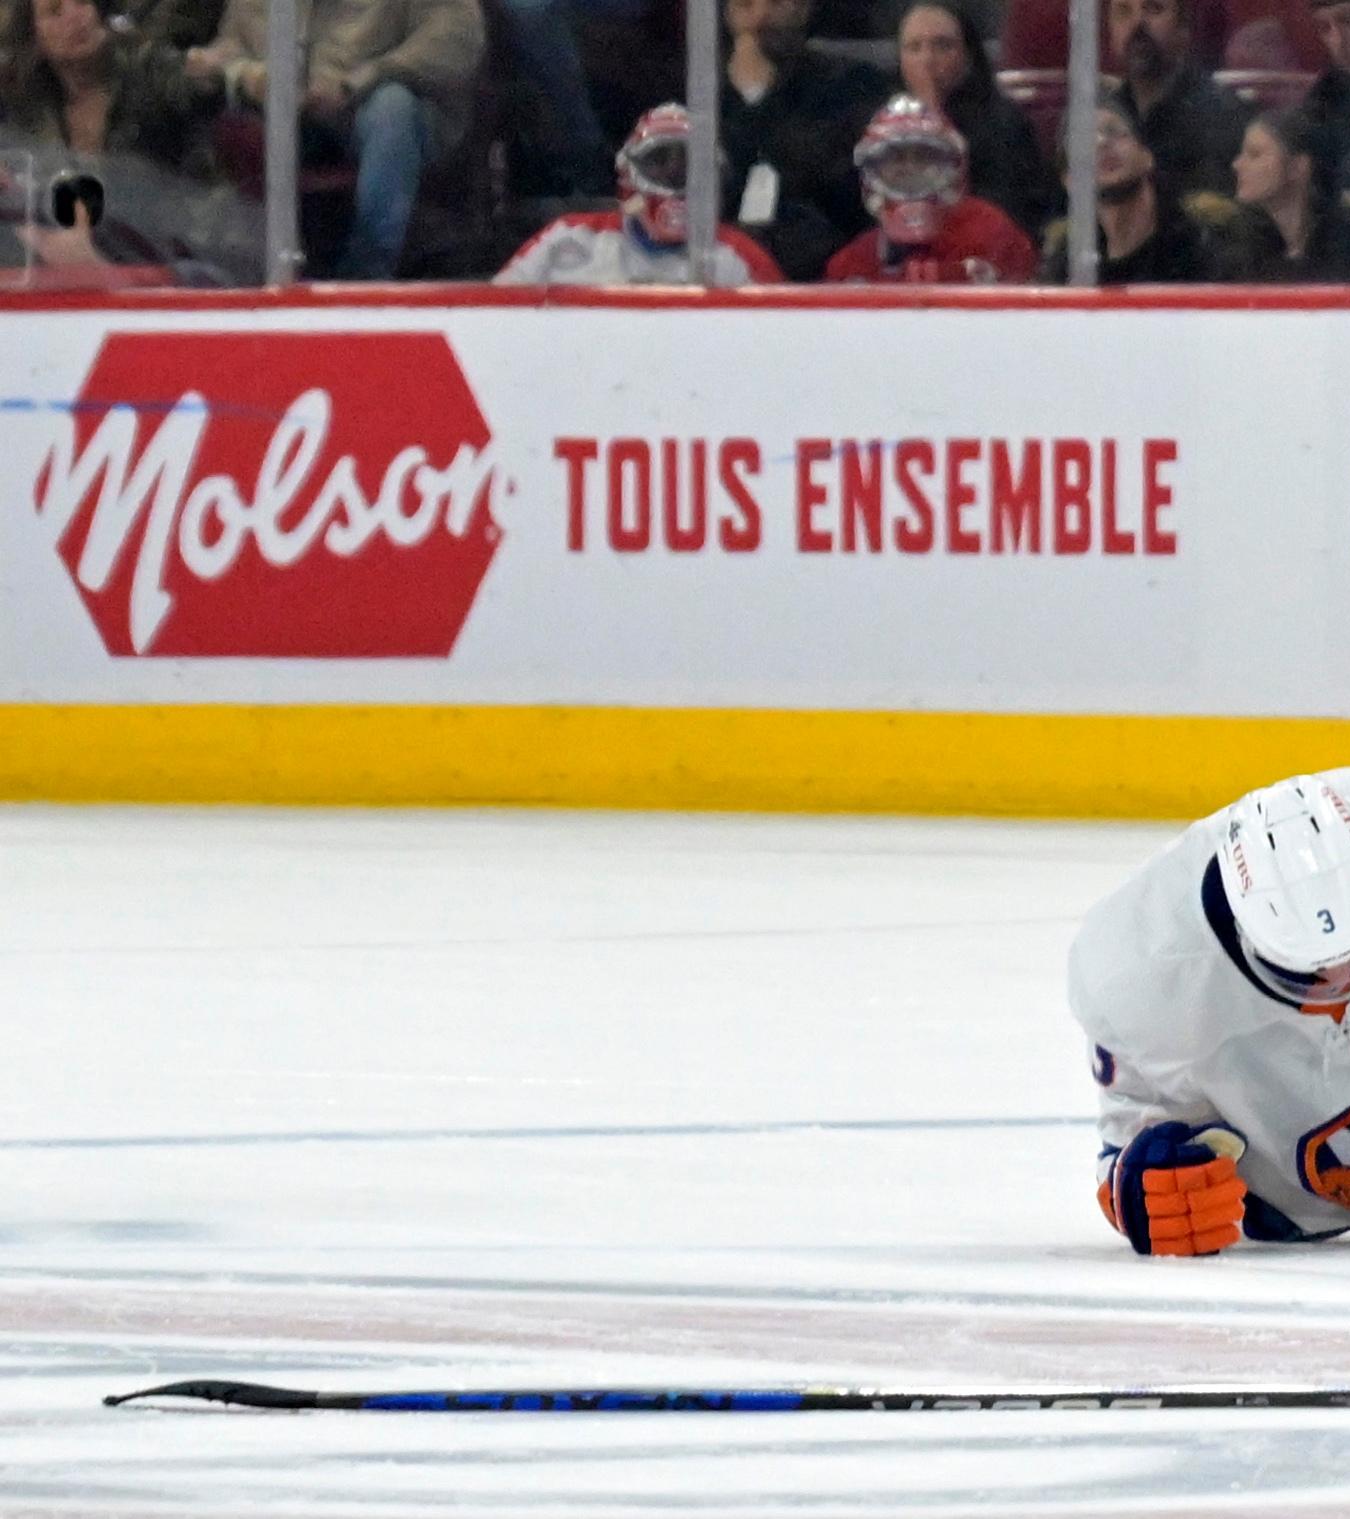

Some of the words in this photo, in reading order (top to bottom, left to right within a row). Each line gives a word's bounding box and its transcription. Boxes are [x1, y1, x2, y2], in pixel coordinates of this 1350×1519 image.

[33, 388, 516, 655] Molson
[554, 437, 763, 554] TOUS
[796, 437, 1179, 556] ENSEMBLE
[1232, 843, 1254, 892] UBS
[1316, 908, 1336, 934] 3
